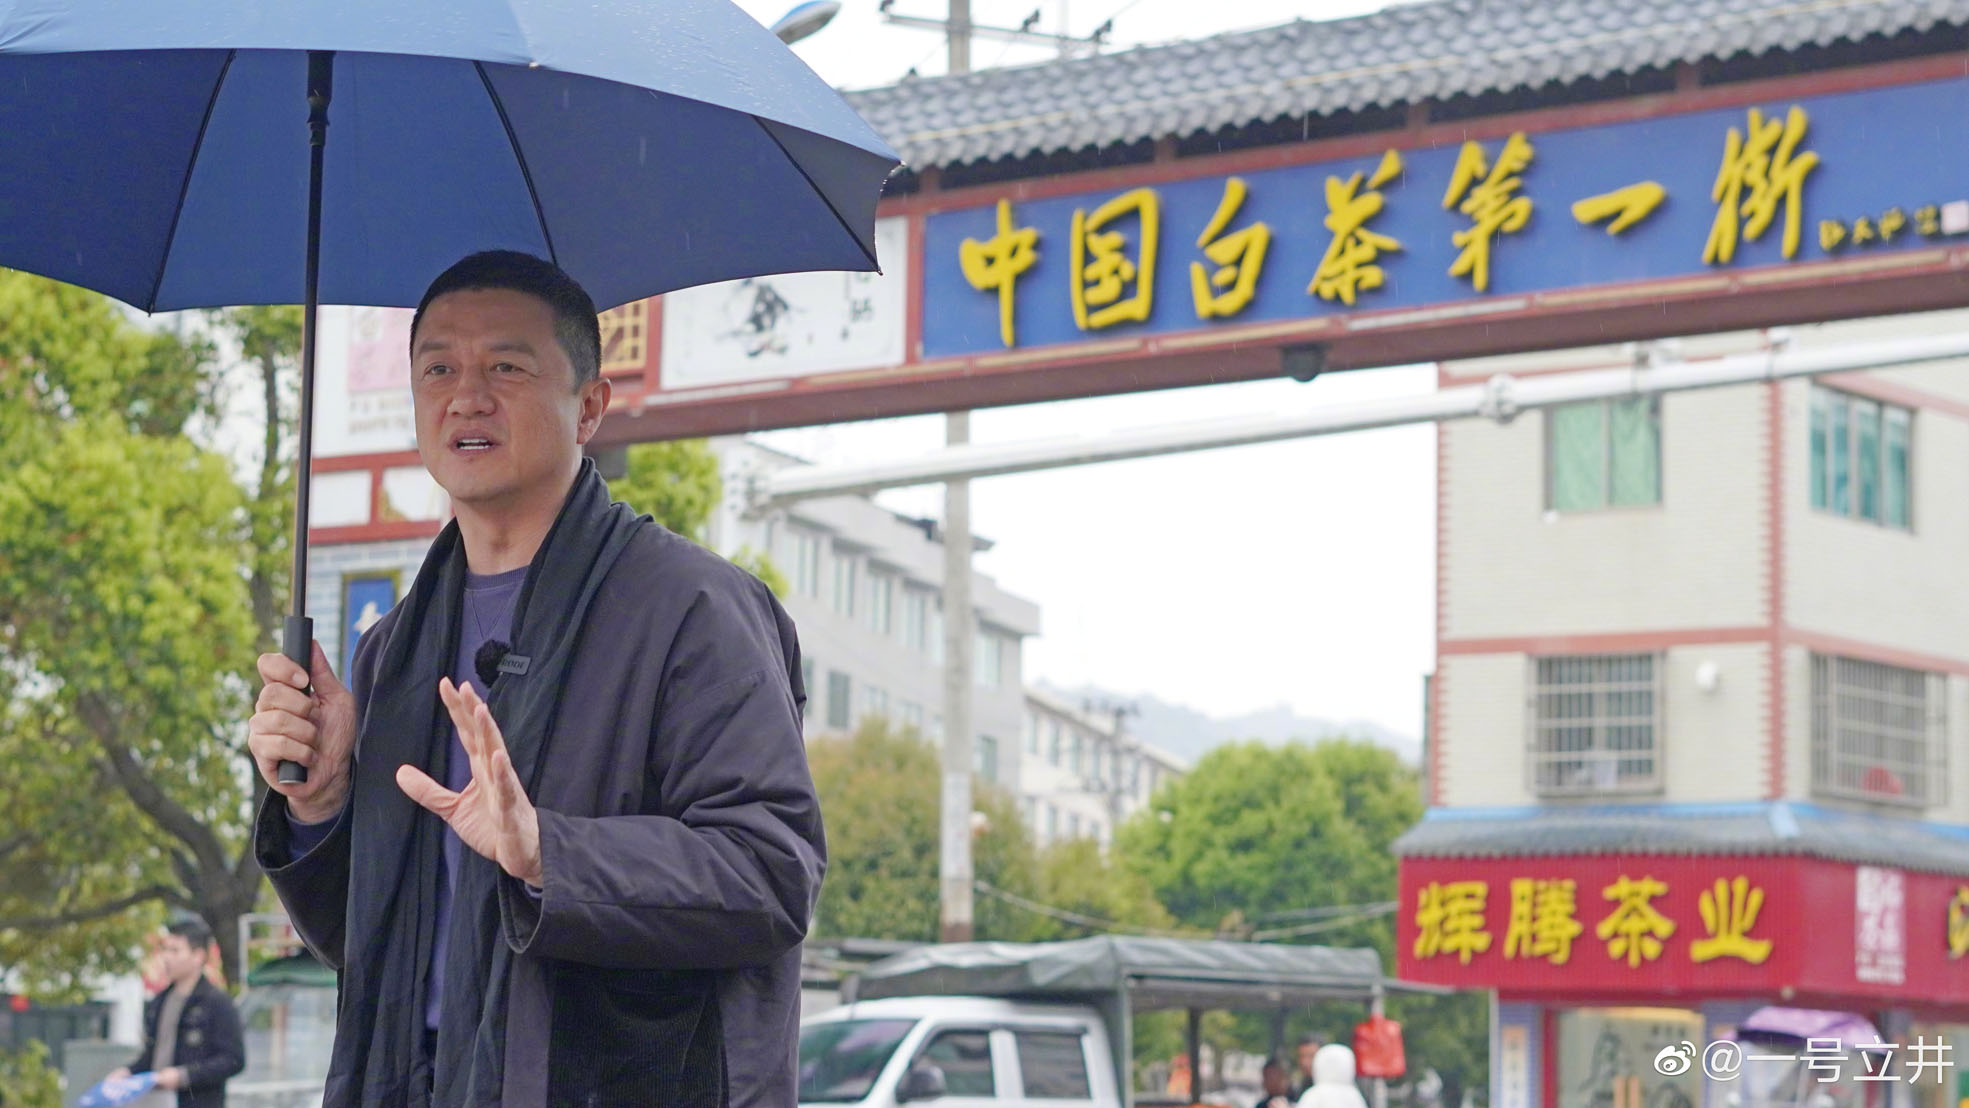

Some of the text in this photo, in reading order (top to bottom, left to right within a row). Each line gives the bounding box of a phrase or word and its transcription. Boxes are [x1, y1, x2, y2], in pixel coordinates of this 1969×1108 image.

[959, 105, 1819, 347] 中国白茶第一街
[1413, 875, 1772, 967] 辉腾茶业
